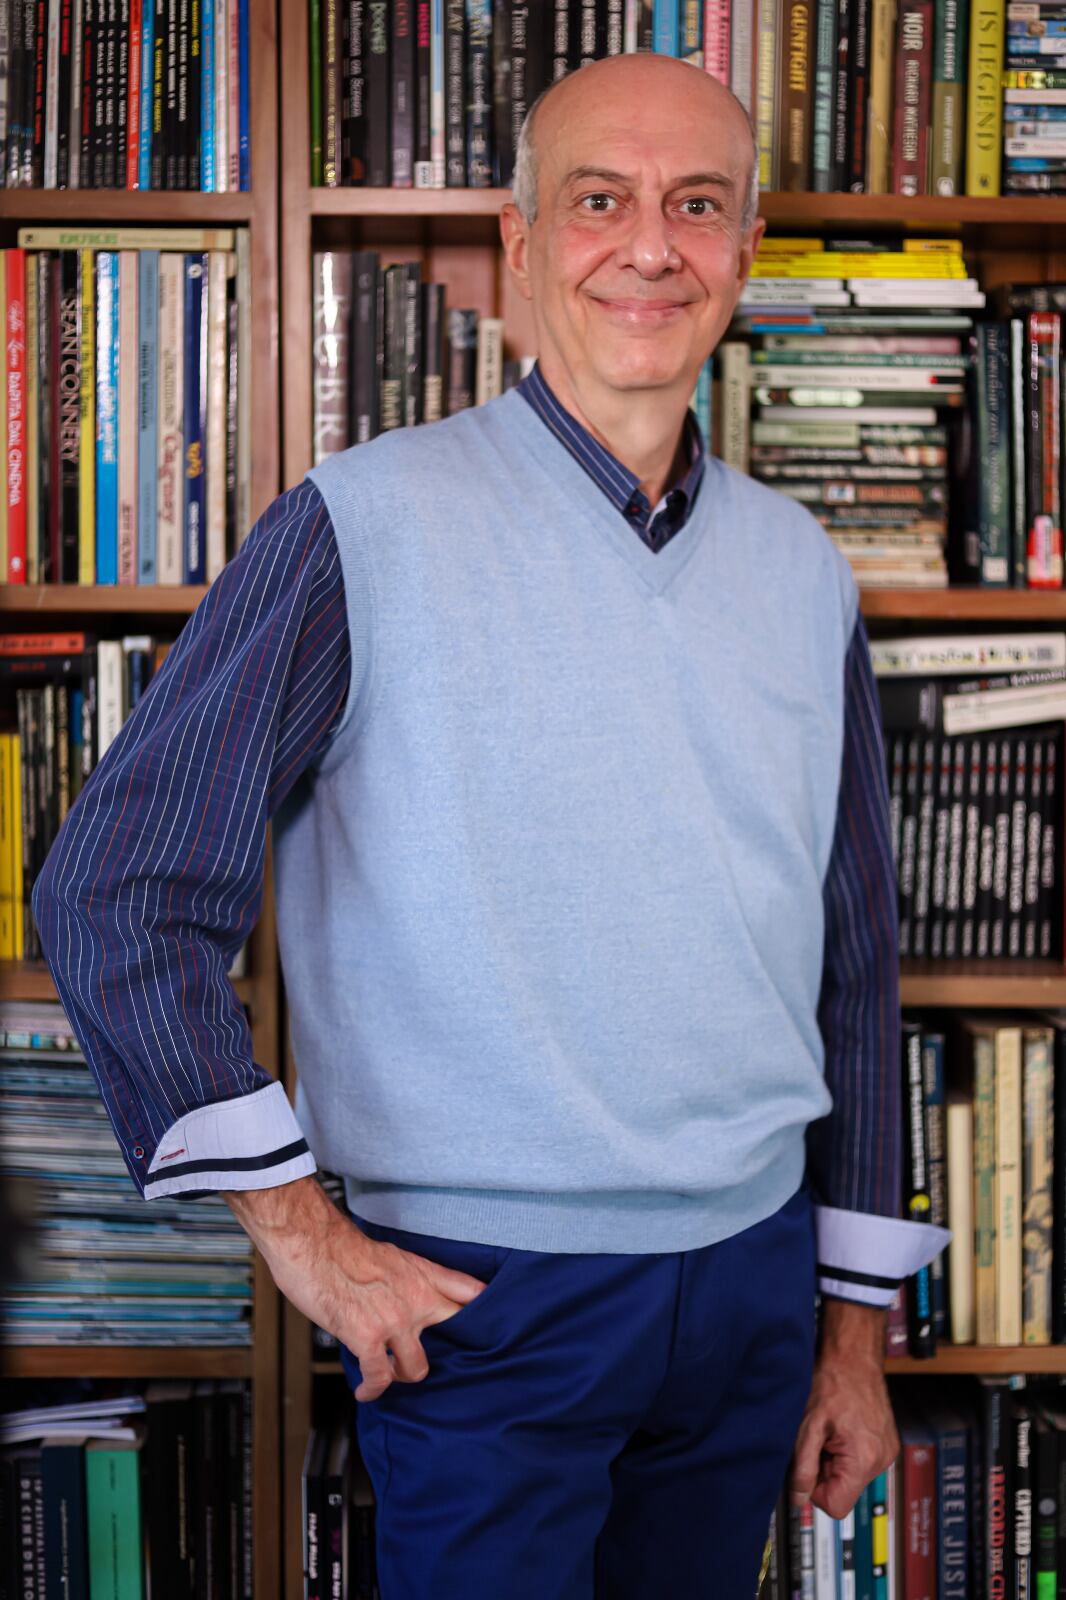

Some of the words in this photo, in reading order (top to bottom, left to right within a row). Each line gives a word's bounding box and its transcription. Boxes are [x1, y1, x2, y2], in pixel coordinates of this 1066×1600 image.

[789, 5, 808, 91] GUNFIGHT
[902, 12, 923, 50] NOIR
[978, 11, 998, 32] IS
[976, 43, 998, 152] LEGEND
[60, 298, 80, 354] SEAN
[60, 358, 80, 464] CONNERY
[8, 449, 22, 507] CINEMA
[158, 432, 183, 524] Cagney
[21, 1479, 32, 1500] DE
[943, 1465, 966, 1528] REEL
[990, 1473, 1005, 1546] RECORD
[21, 1504, 32, 1546] CINE
[35, 1498, 44, 1552] FESTIVAL
[1014, 1488, 1032, 1555] CAPTURED
[22, 1550, 33, 1572] DE
